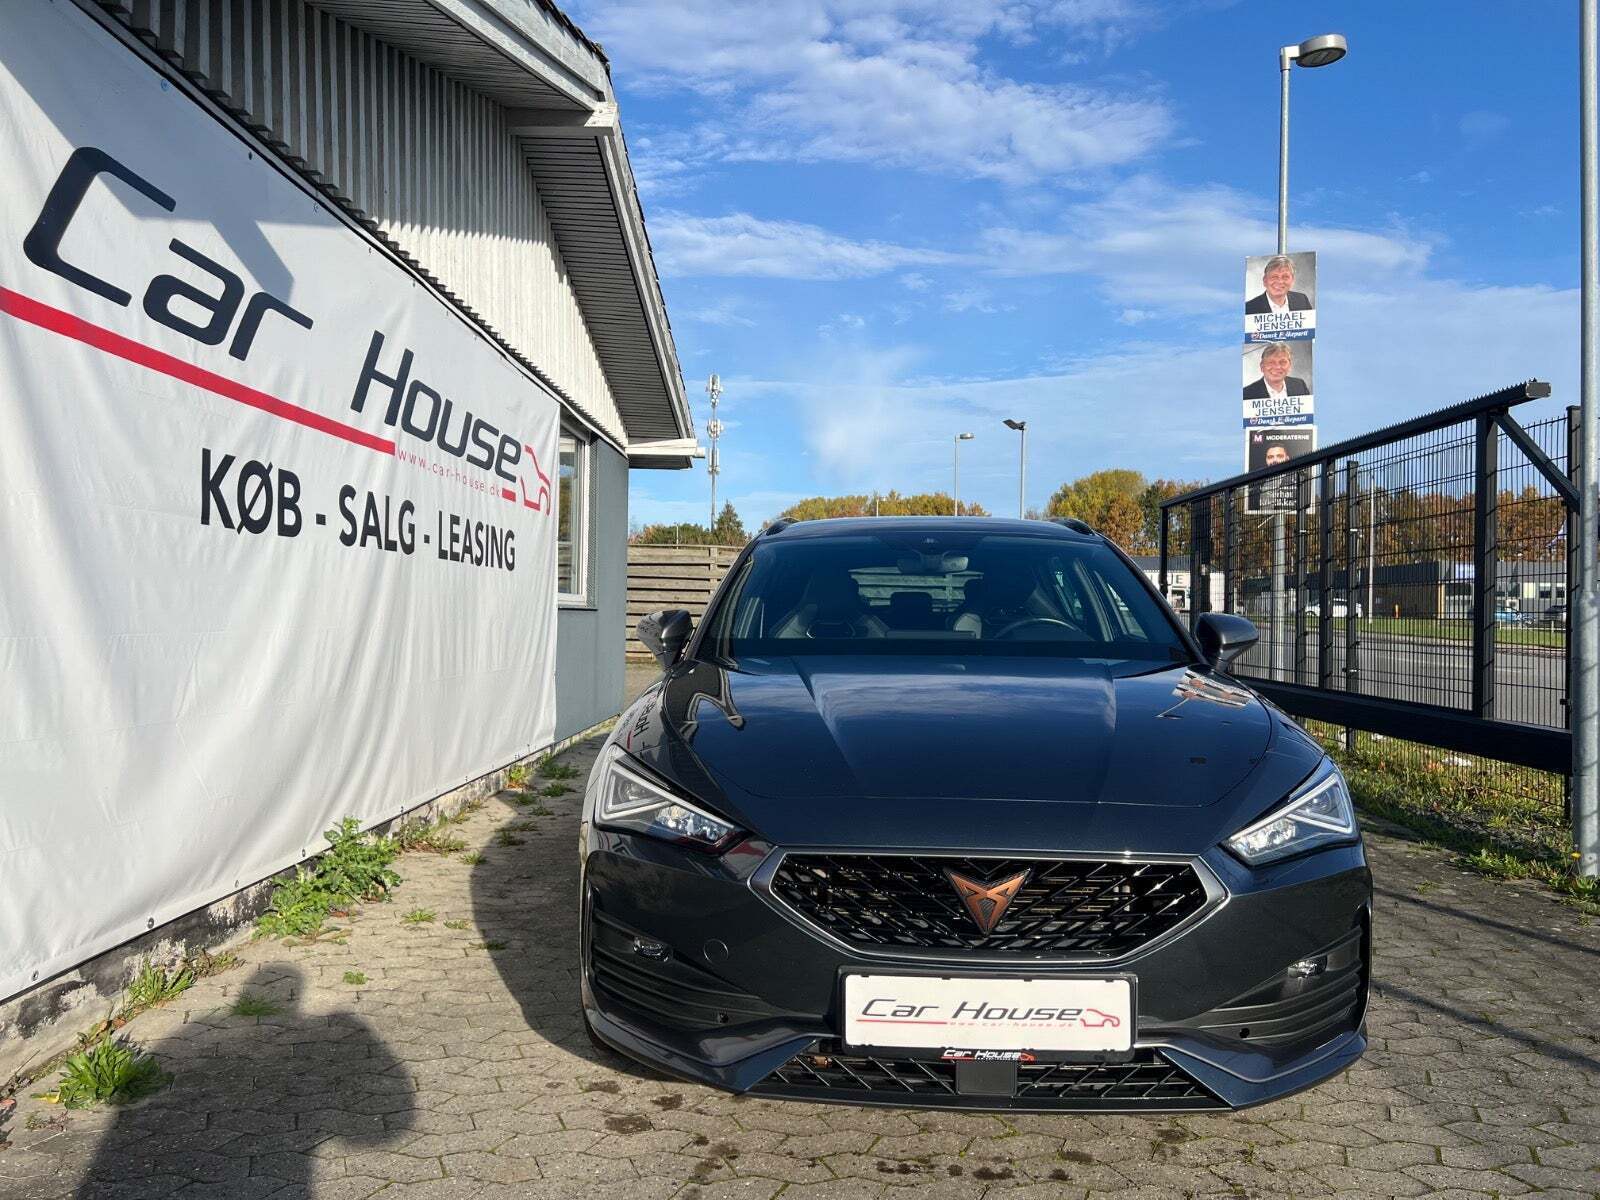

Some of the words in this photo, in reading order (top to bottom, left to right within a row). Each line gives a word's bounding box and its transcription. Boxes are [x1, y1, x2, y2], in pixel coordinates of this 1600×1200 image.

[23, 146, 314, 362] Car
[350, 330, 522, 483] House
[1254, 312, 1305, 323] MICHAEL
[1257, 321, 1302, 331] JENSEN
[1252, 398, 1304, 408] MICHAEL
[1255, 406, 1300, 416] JENSEN
[399, 450, 501, 497] www.car-house.dk
[200, 447, 303, 536] KØB
[338, 484, 416, 556] SALG
[438, 510, 515, 572] LEASING
[862, 998, 939, 1018] Car
[951, 1001, 1083, 1021] House
[943, 1049, 972, 1058] Car
[974, 1050, 1021, 1060] House
